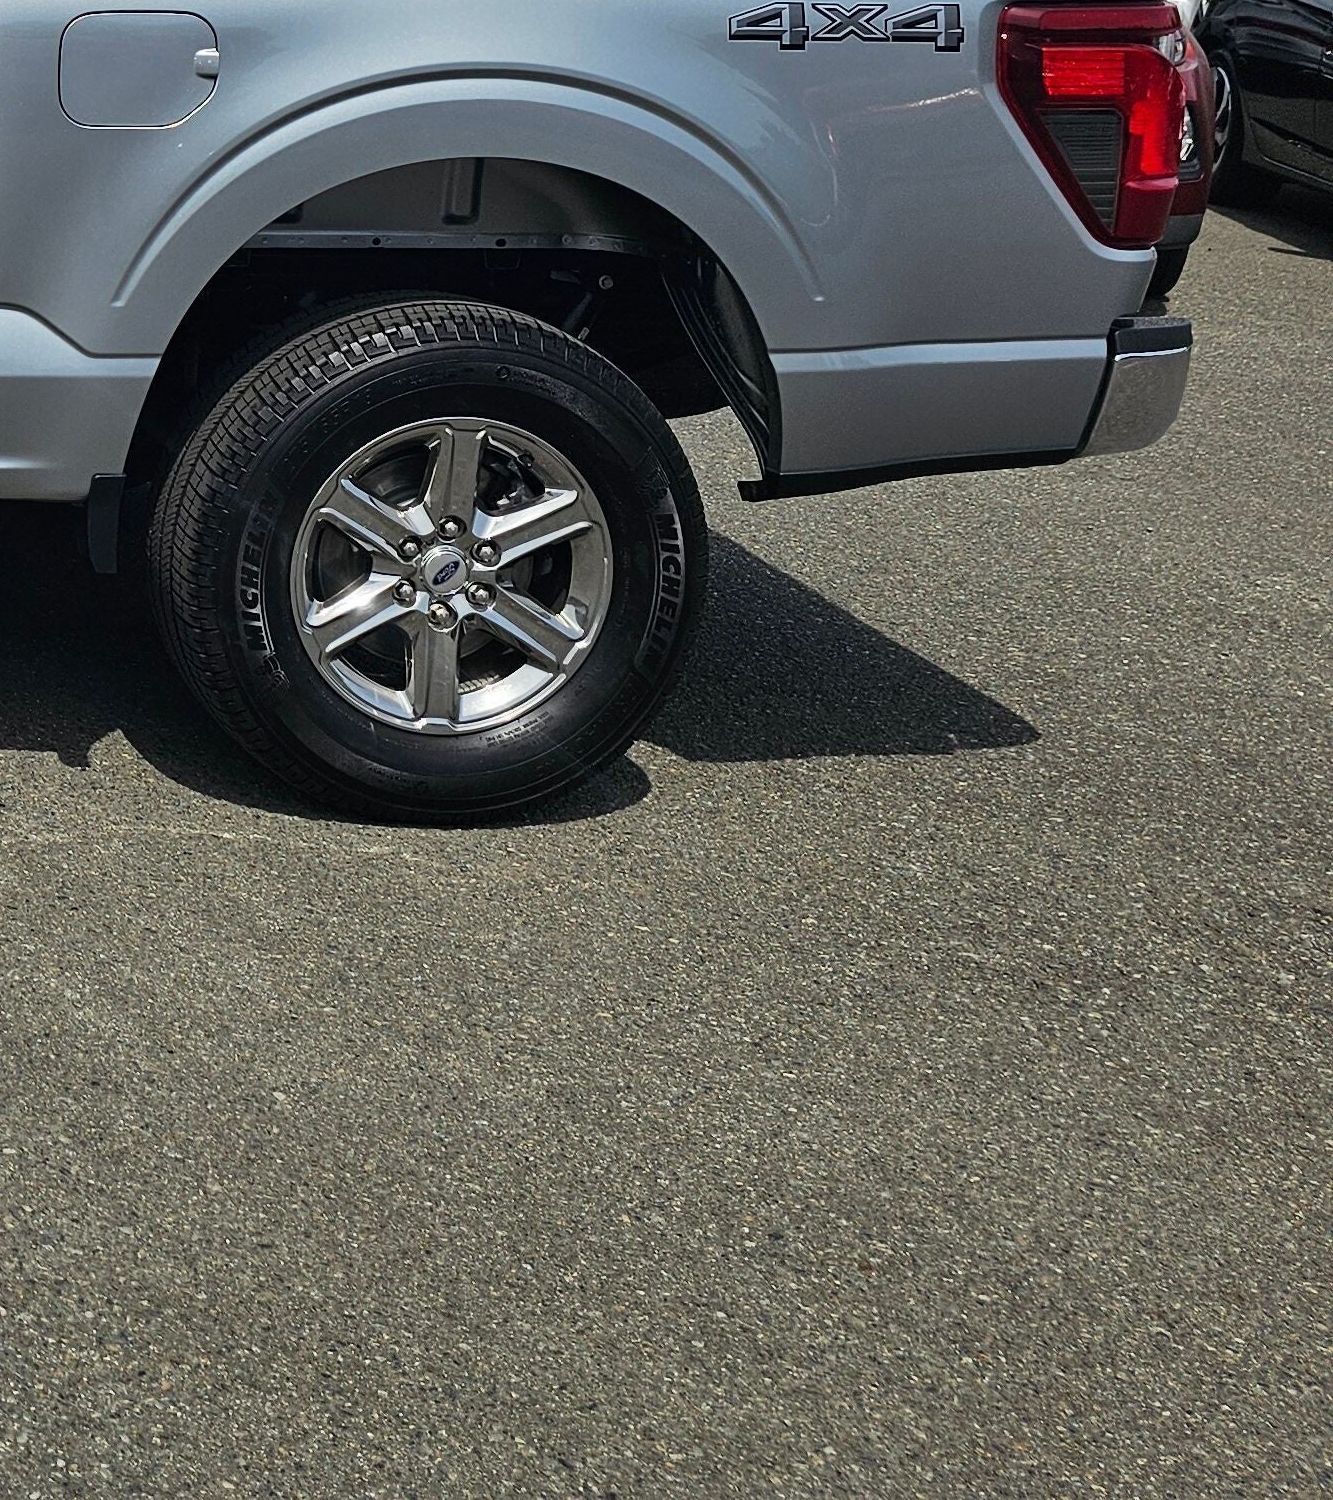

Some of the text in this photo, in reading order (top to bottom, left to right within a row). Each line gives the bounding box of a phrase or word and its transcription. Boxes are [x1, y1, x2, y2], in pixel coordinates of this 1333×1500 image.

[728, 1, 965, 53] 4X4
[437, 563, 455, 583] Ford
[640, 513, 682, 672] MICHELIN
